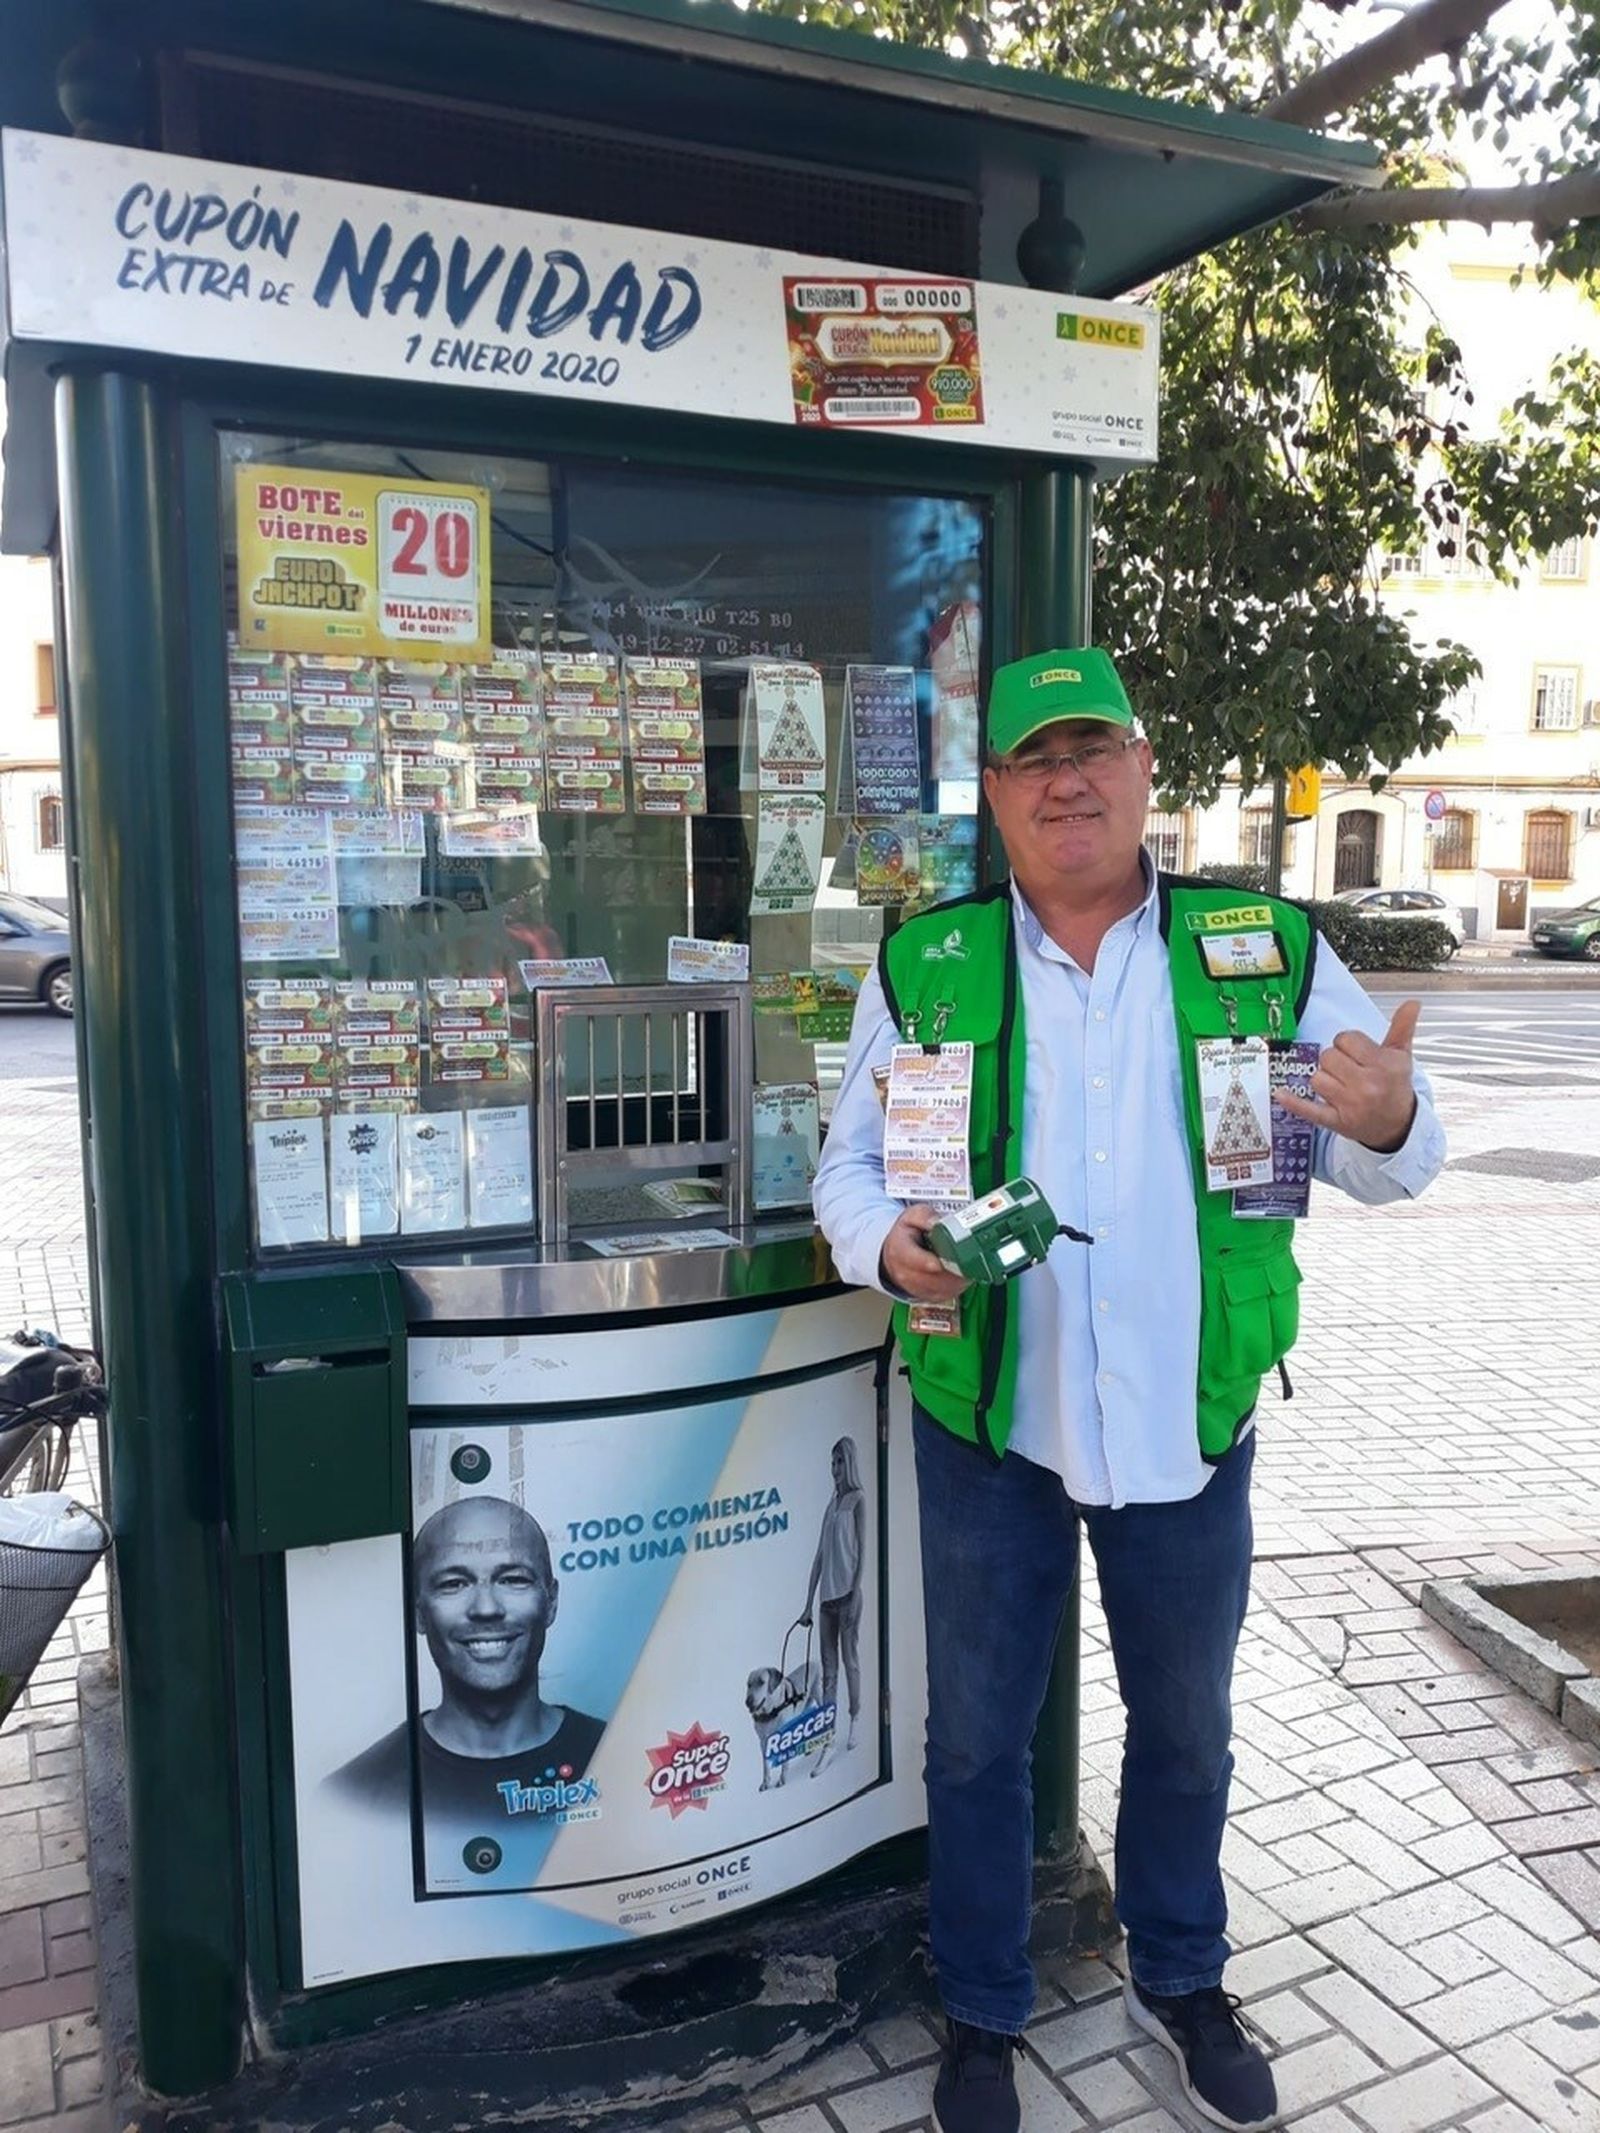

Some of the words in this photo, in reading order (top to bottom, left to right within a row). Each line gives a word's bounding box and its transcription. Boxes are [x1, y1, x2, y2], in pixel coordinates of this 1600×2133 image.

[115, 183, 300, 259] CUPÓN
[117, 247, 249, 300] EXTRA
[260, 279, 295, 306] DE
[313, 218, 702, 353] NAVIDAD
[904, 289, 961, 307] 00000
[870, 325, 938, 353] Navidad
[1081, 320, 1140, 345] ONCE
[405, 335, 422, 362] 1
[430, 338, 533, 377] ENERO
[540, 350, 620, 387] 2020
[1052, 410, 1077, 420] grupo
[1079, 413, 1102, 423] social
[1105, 415, 1144, 431] ONCE
[258, 485, 342, 517] BOTE
[347, 508, 364, 519] del
[258, 514, 369, 546] viernes
[391, 507, 471, 579] 20
[275, 556, 337, 583] EURO
[384, 603, 474, 623] MILLONES
[725, 610, 761, 626] T25
[399, 621, 415, 632] de
[420, 622, 456, 634] euros
[1044, 670, 1079, 681] ONCE
[1210, 909, 1266, 926] ONCE
[941, 1045, 965, 1055] 9406
[269, 1134, 307, 1149] Triplex
[929, 1150, 959, 1159] 79406
[567, 1514, 645, 1544] TODO
[652, 1487, 782, 1532] COMIENZA
[559, 1546, 620, 1573] CON
[629, 1536, 687, 1563] UNA
[695, 1511, 789, 1552] ILUSIÓN
[765, 1704, 836, 1758] Rascas
[673, 1736, 729, 1768] Super
[650, 1752, 731, 1797] Once
[497, 1777, 600, 1816] Triplex
[702, 1783, 727, 1796] ONCE
[569, 1810, 600, 1821] ONCE
[617, 1887, 656, 1904] grupo
[658, 1876, 692, 1893] social
[696, 1855, 751, 1885] ONCE
[728, 1884, 750, 1897] ONCE
